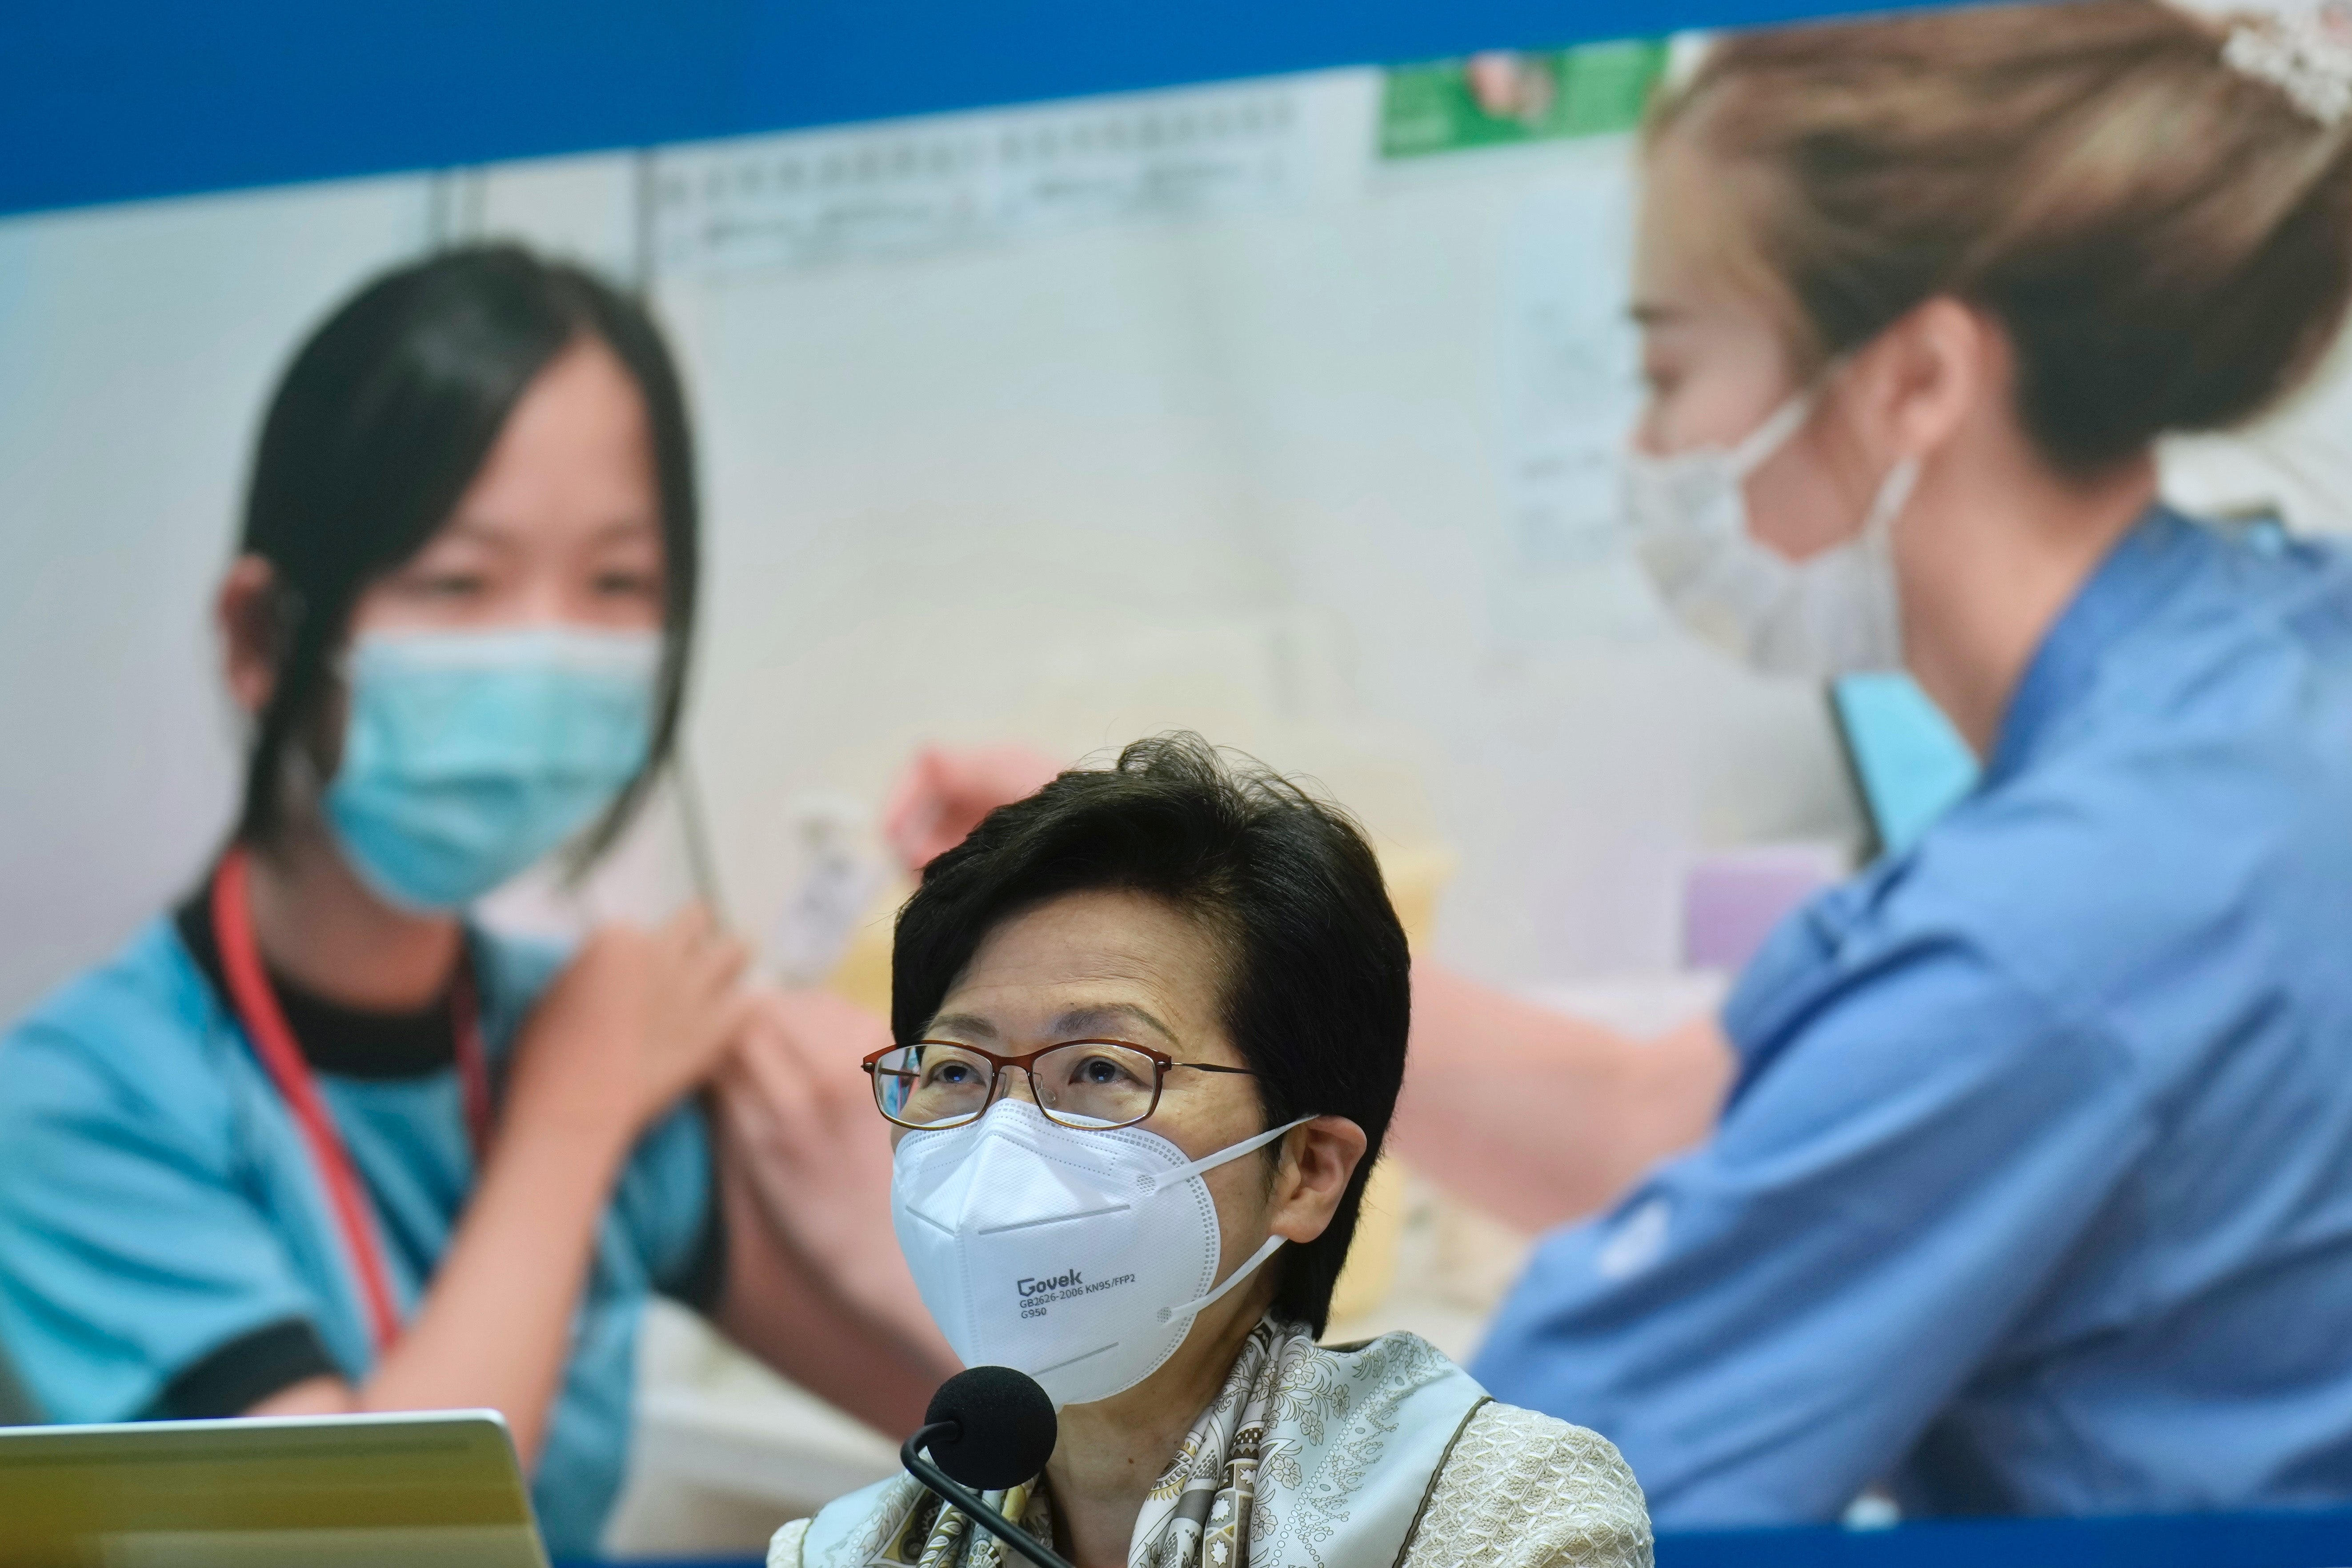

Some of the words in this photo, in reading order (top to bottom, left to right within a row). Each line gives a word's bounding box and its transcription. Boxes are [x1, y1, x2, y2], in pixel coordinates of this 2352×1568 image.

[1017, 1269, 1083, 1296] Govek
[1020, 1287, 1083, 1308] GB2626-2006
[1085, 1274, 1135, 1294] KN95/FFP2
[1021, 1307, 1046, 1319] G950
